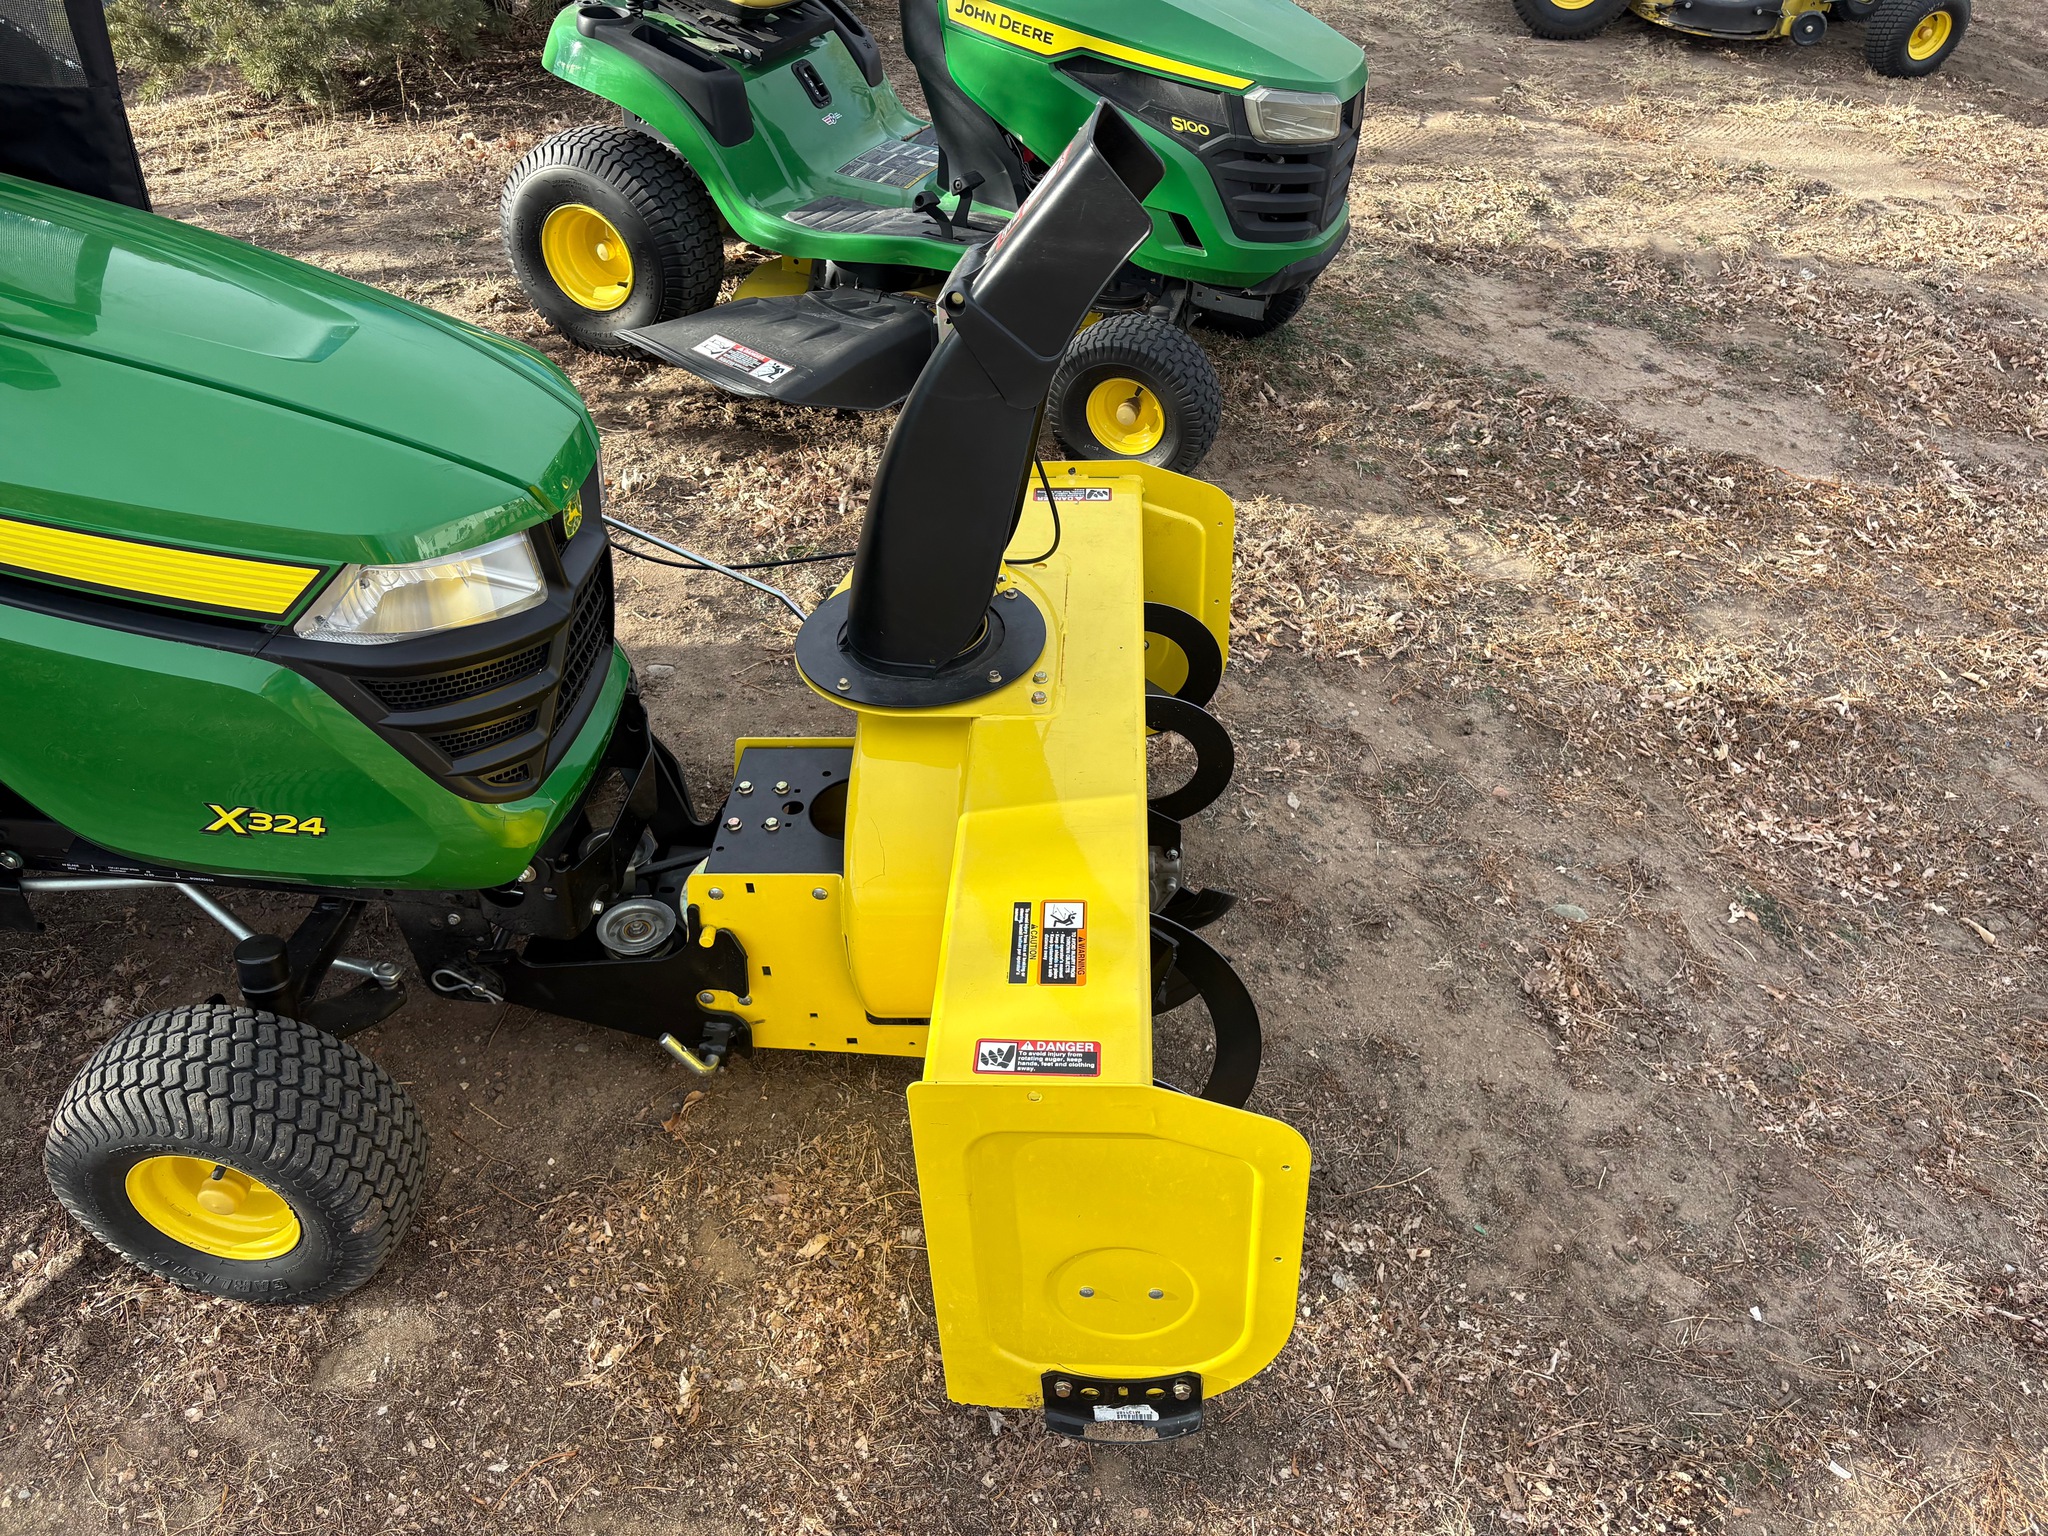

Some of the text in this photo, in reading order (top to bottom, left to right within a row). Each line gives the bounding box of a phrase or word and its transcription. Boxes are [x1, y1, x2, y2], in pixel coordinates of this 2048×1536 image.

[955, 0, 1054, 45] JOHN DEERE
[1171, 116, 1210, 136] S100
[202, 803, 327, 837] X324
[1036, 1042, 1094, 1052] DANGER
